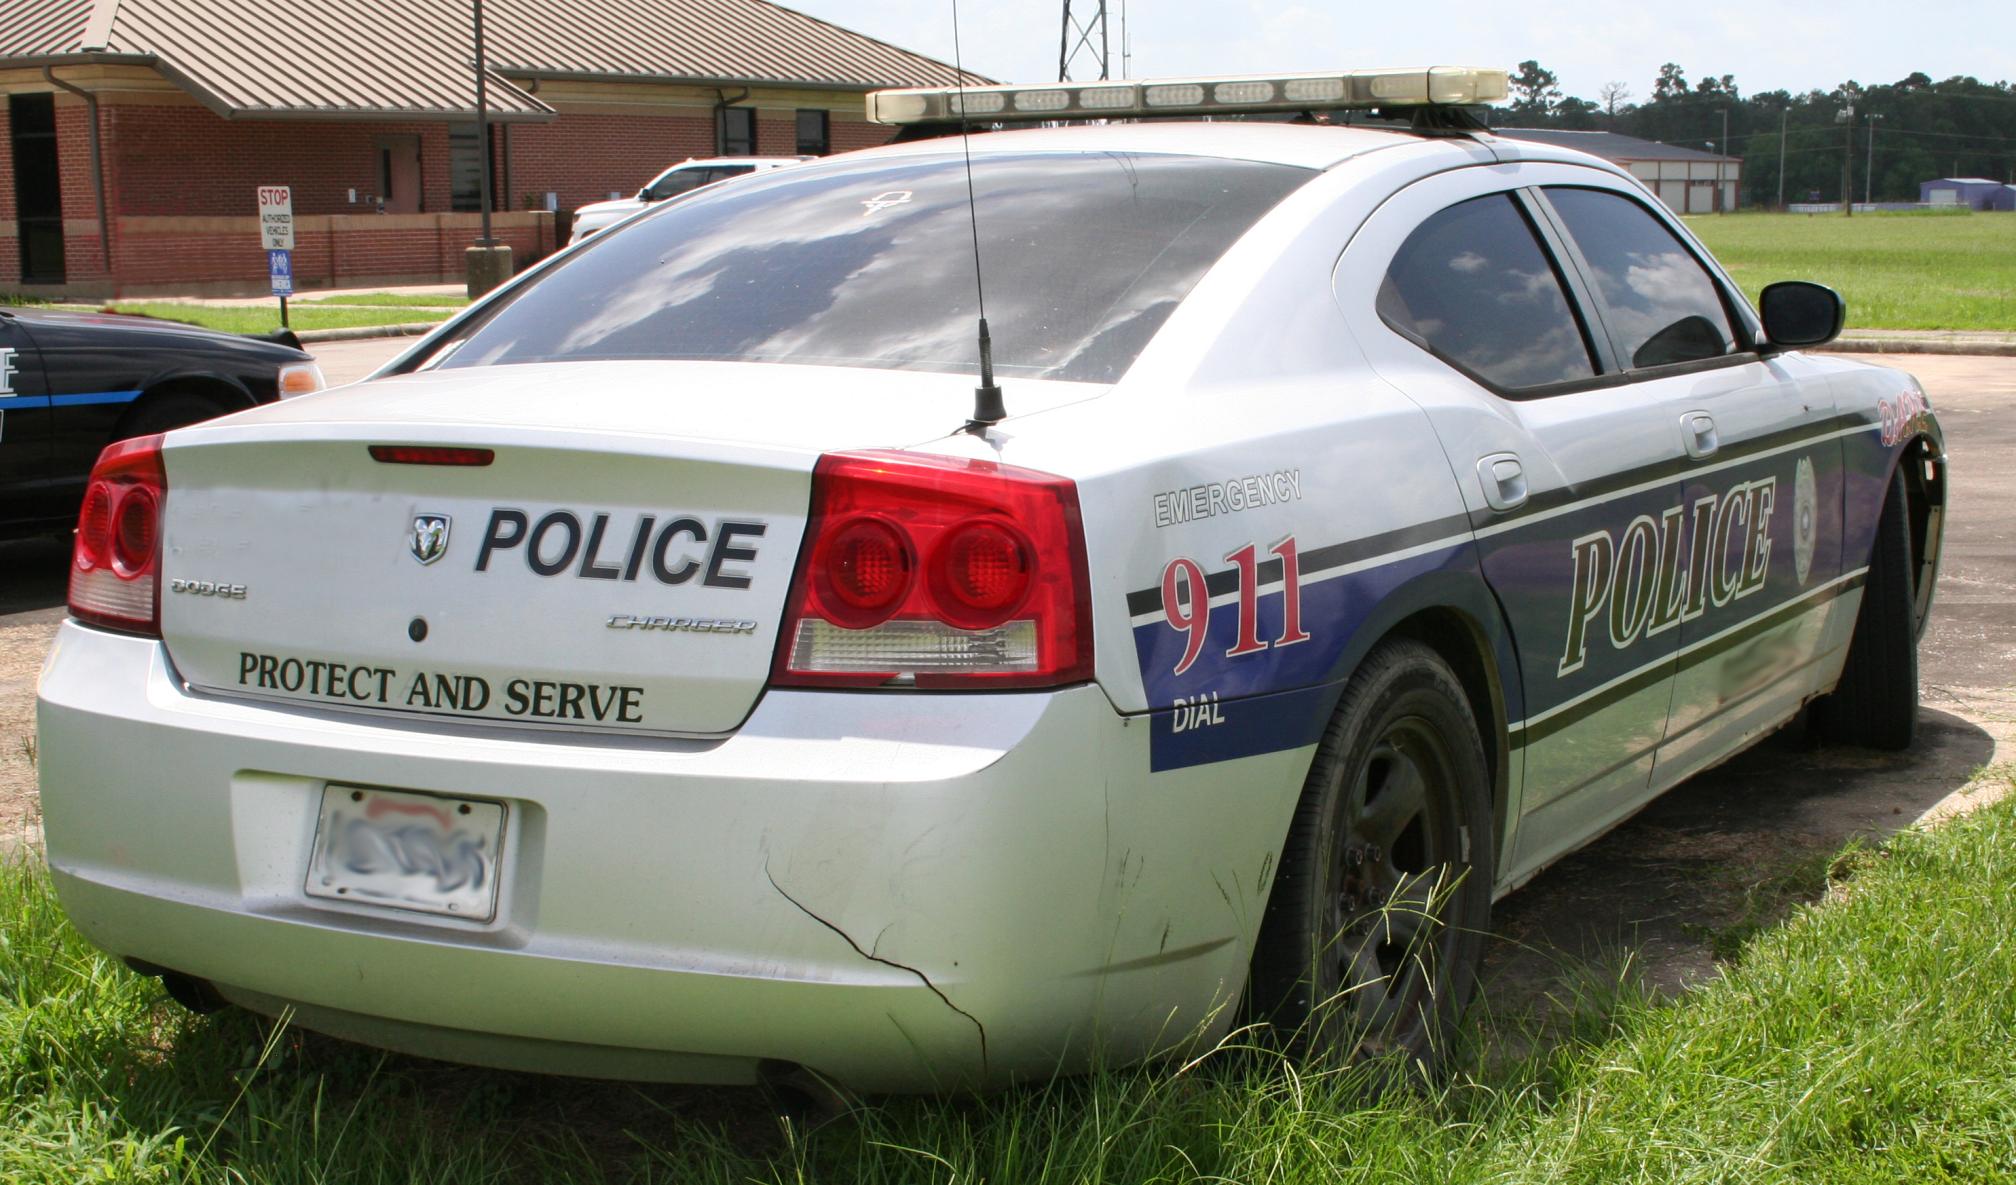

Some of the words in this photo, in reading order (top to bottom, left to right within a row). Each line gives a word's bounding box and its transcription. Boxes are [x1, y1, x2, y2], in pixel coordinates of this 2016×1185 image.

[260, 189, 288, 205] STOP
[1154, 469, 1302, 528] EMERGENCY
[474, 507, 769, 590] POLICE
[1557, 475, 1776, 678] POLICE
[172, 579, 247, 600] DODGE
[1160, 533, 1310, 677] 911
[606, 614, 757, 634] CHARGER
[239, 652, 396, 703] PROTECT
[406, 672, 490, 712] AND
[504, 679, 644, 723] SERVE
[1172, 691, 1225, 733] DIAL
